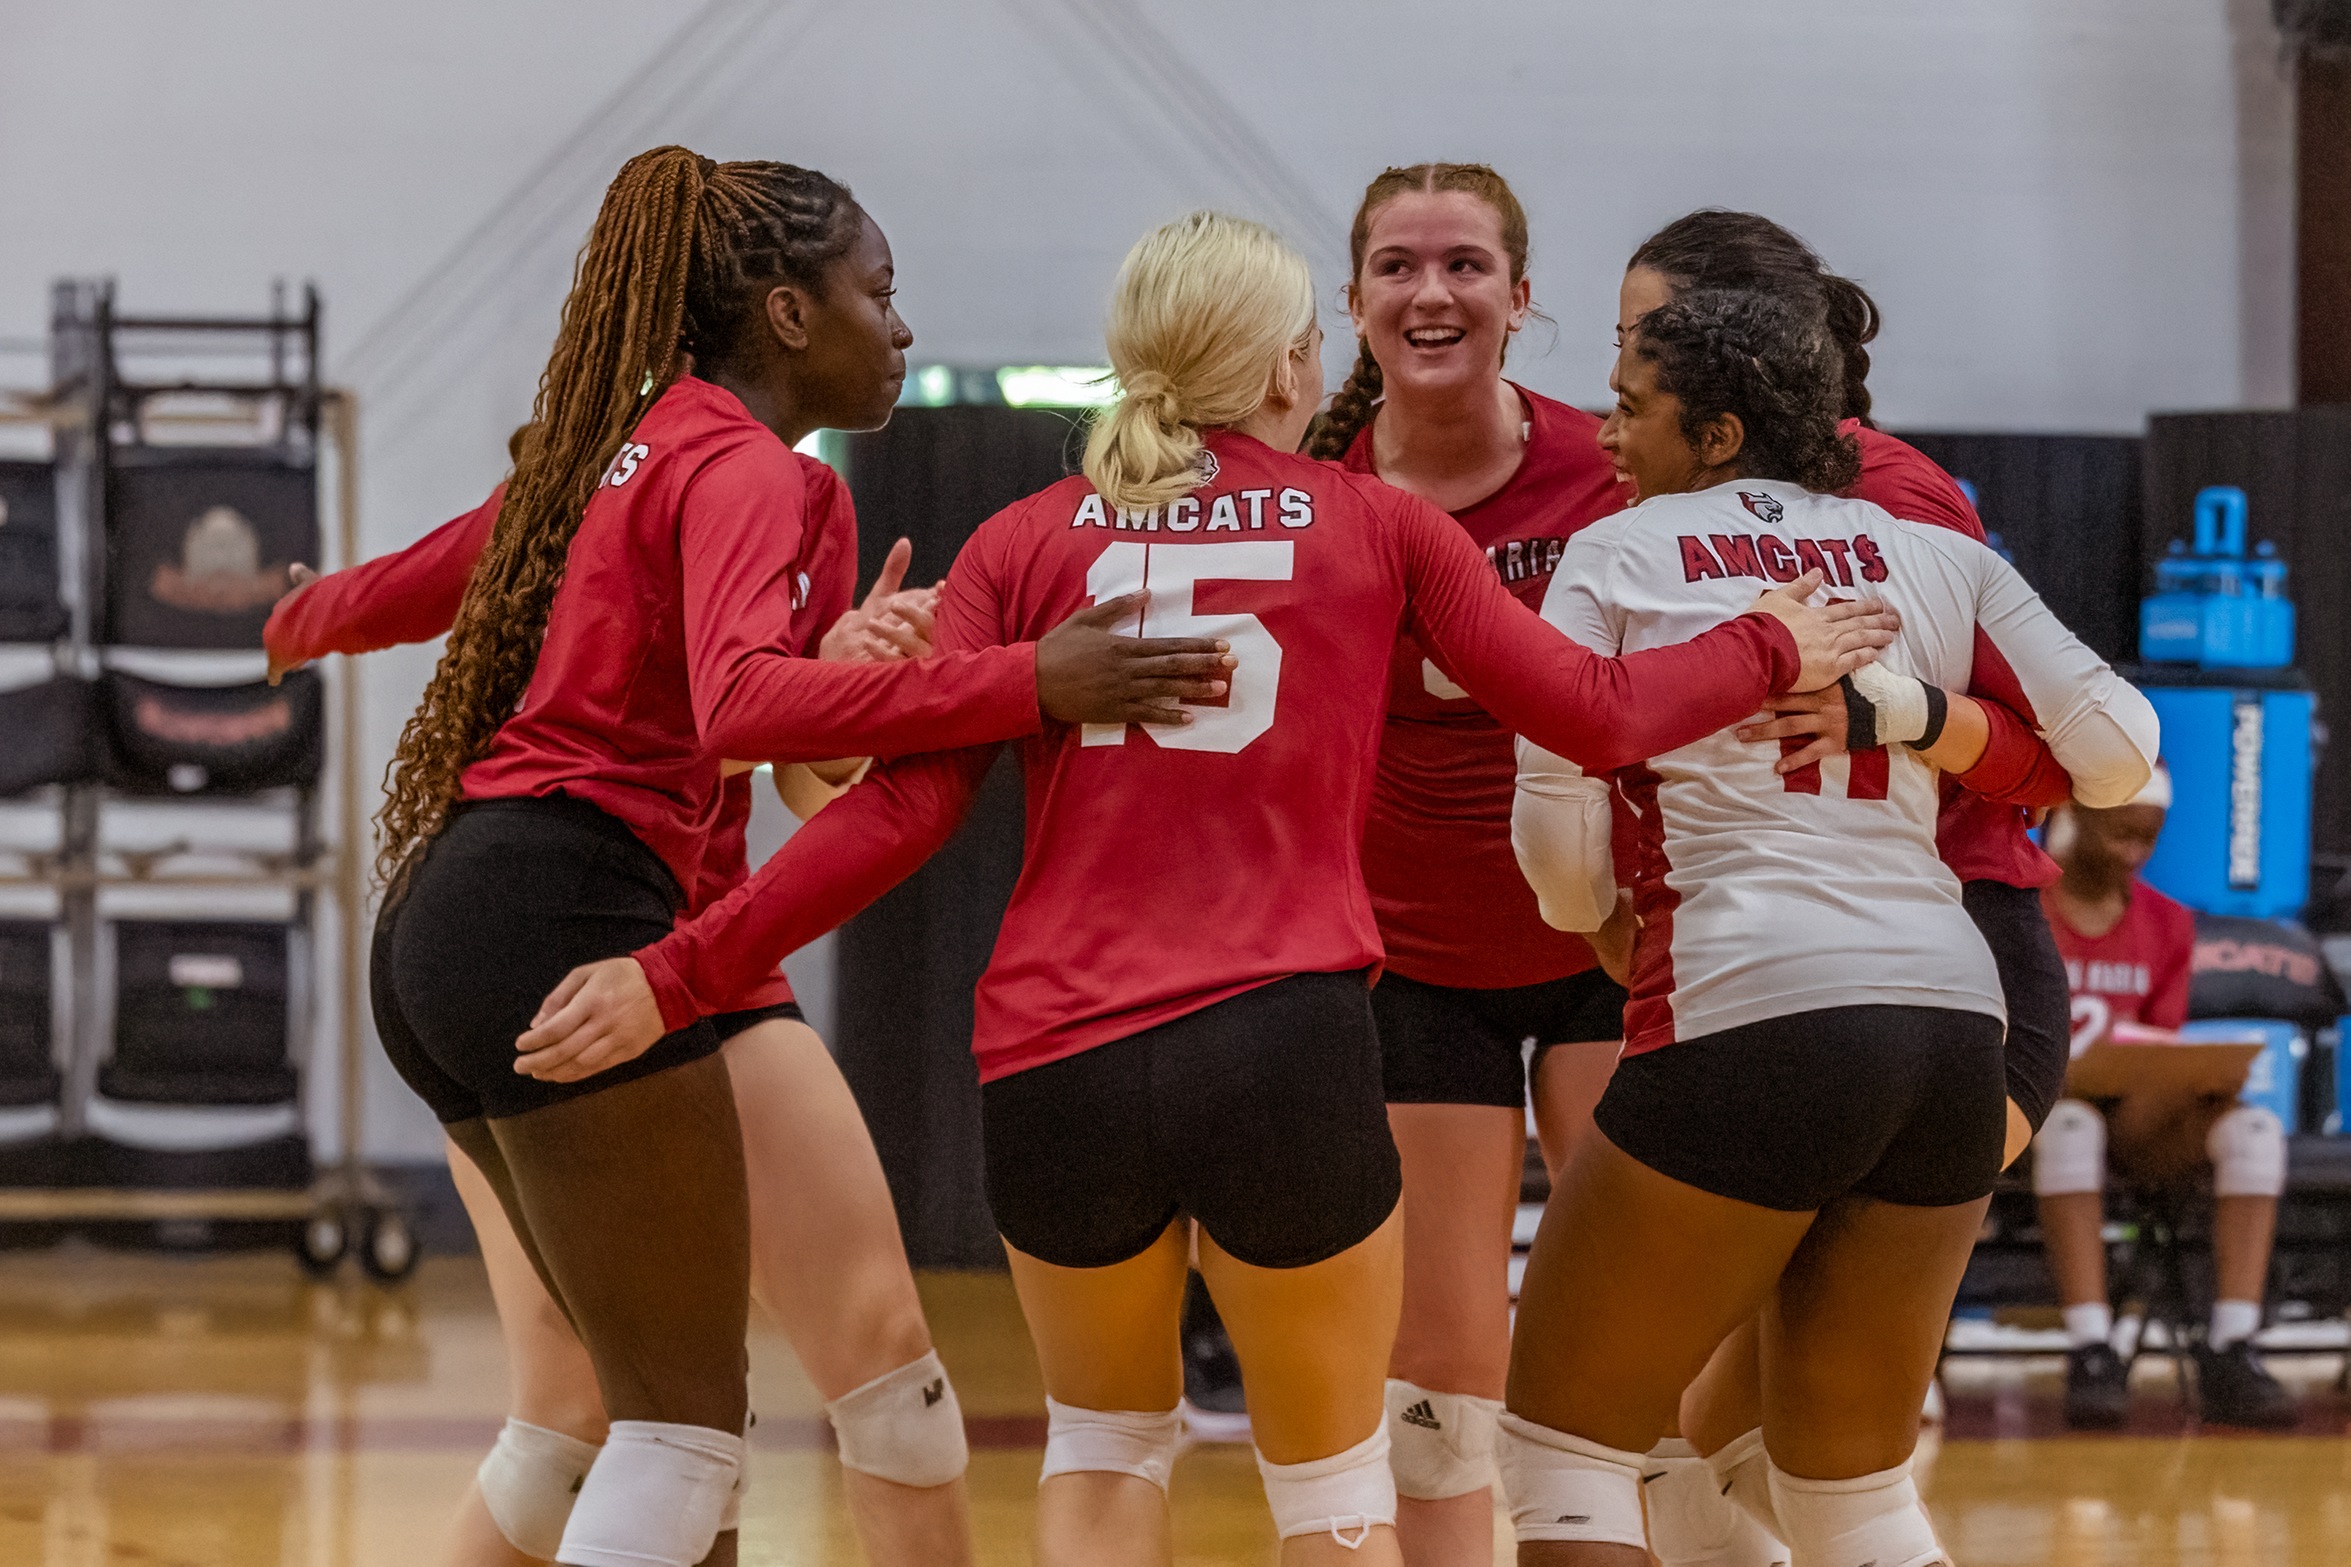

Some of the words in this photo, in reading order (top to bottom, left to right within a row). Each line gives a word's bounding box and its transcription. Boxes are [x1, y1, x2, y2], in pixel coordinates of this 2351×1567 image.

[1070, 486, 1314, 533] AMCATS
[1677, 533, 1889, 588] AMCATS
[1081, 540, 1295, 755] 15
